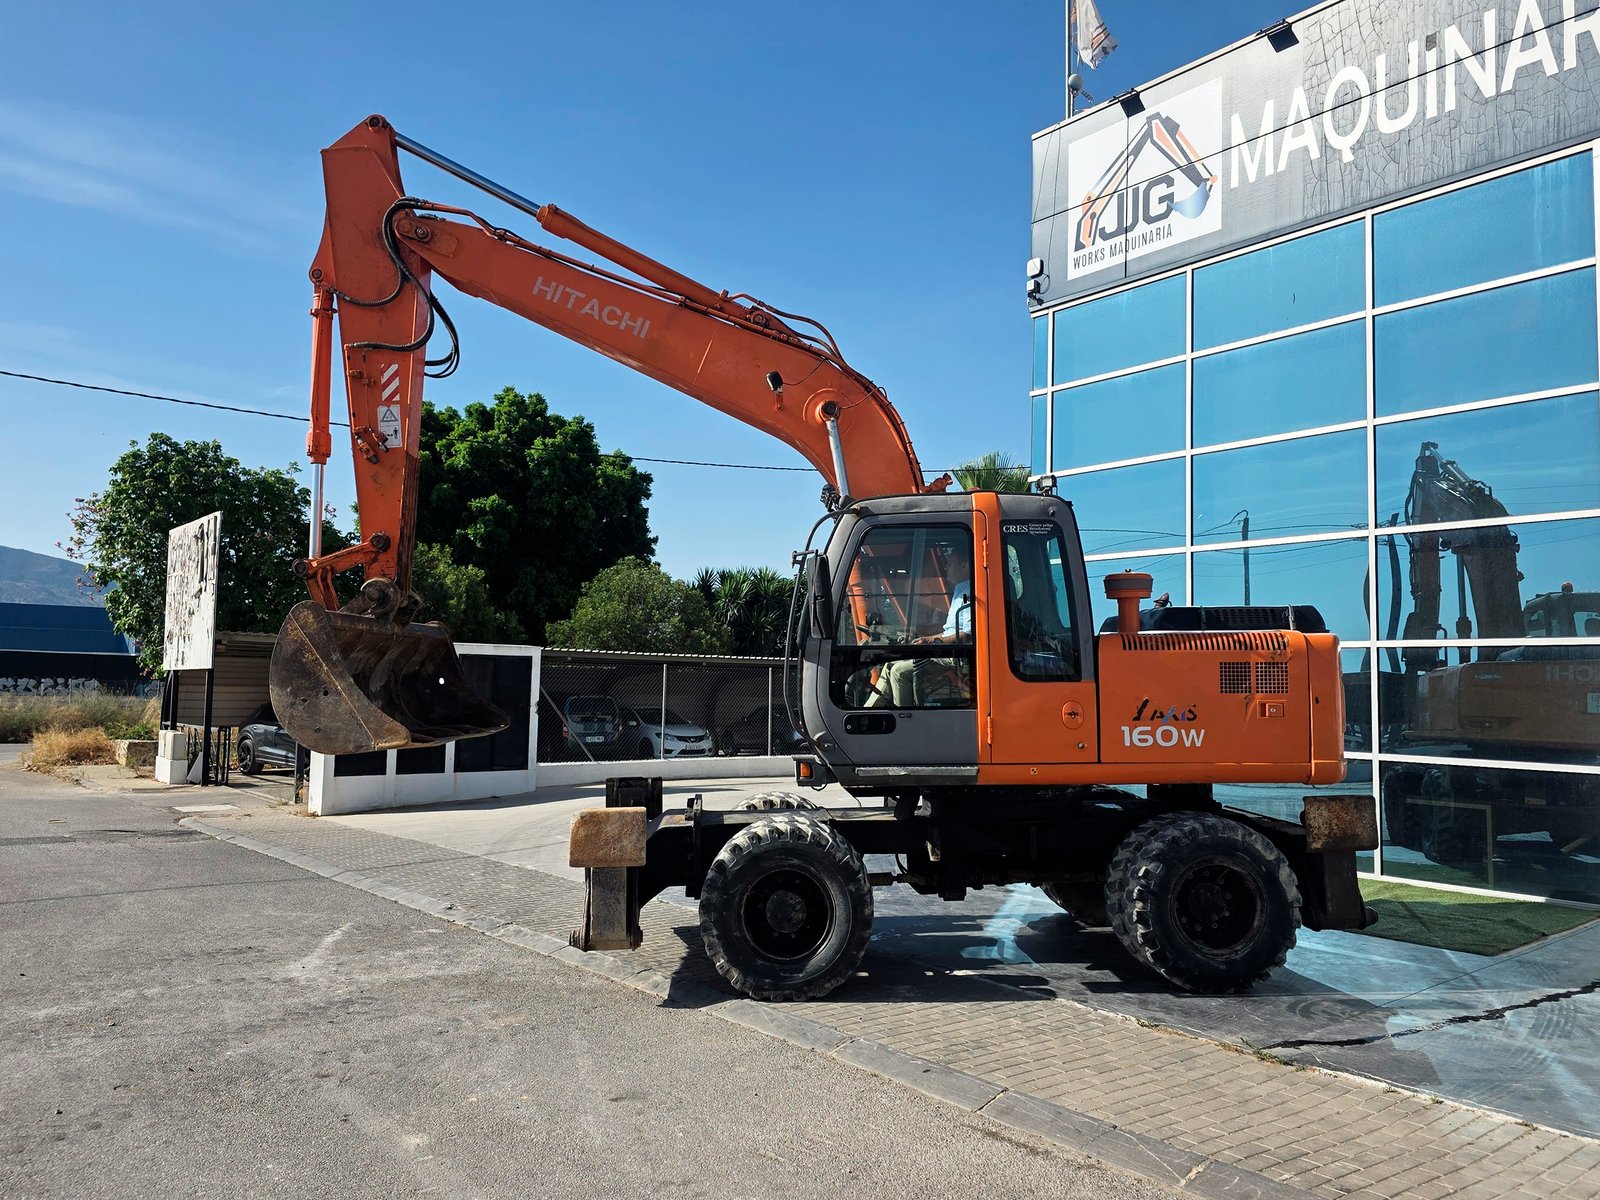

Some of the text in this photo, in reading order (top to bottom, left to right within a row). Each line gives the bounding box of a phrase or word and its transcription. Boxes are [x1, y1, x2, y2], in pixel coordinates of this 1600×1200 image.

[1073, 223, 1173, 270] WORKS MAQUINARIA
[531, 275, 652, 339] HITACHI
[1003, 524, 1028, 533] CRES
